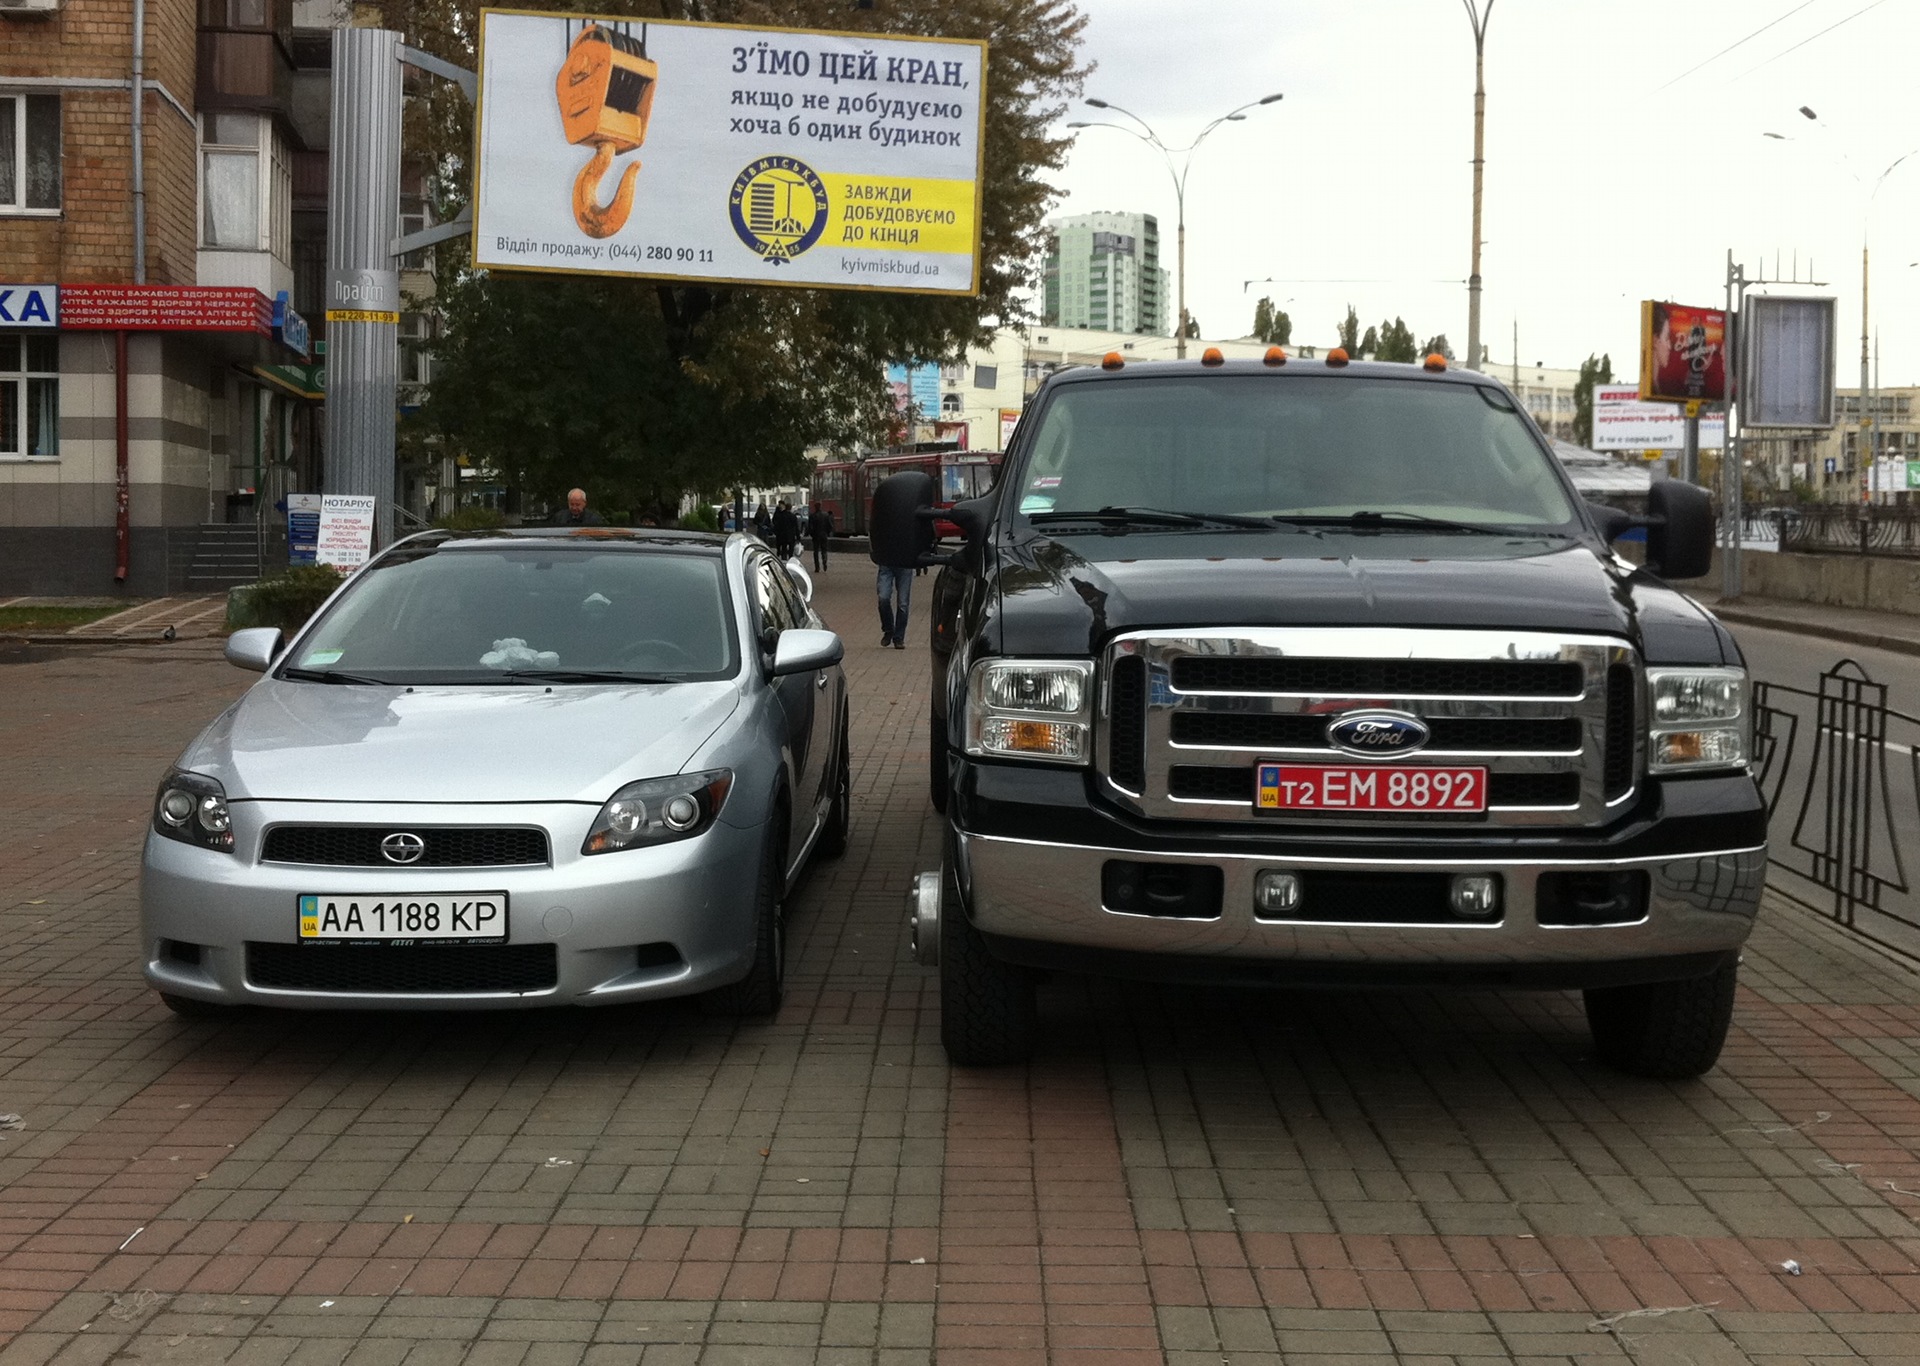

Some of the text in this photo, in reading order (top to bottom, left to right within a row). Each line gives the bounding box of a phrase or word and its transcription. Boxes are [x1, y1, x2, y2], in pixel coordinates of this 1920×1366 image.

[819, 50, 878, 84] ЦЕЙ
[886, 57, 969, 90] КРАН,
[730, 90, 962, 121] якщо не добудуємо
[730, 116, 961, 147] хоча б один будинок
[731, 157, 828, 211] КИЇВМІСЬКБУД
[844, 184, 911, 204] ЗАВЖДИ
[843, 205, 955, 225] ДОБУДОВУЄМО
[842, 226, 919, 244] ДО КІНЦЯ
[497, 236, 713, 262] Відділ продажу: (044) 280 90 11
[841, 257, 939, 275] kyivmiskbud.ua
[324, 499, 373, 508] НОТАРІУС
[1350, 721, 1407, 746] Ford
[1262, 793, 1277, 802] UA
[1281, 771, 1475, 807] T2 EM 8892
[304, 922, 317, 931] UA
[321, 902, 497, 932] AA 1188 KP
